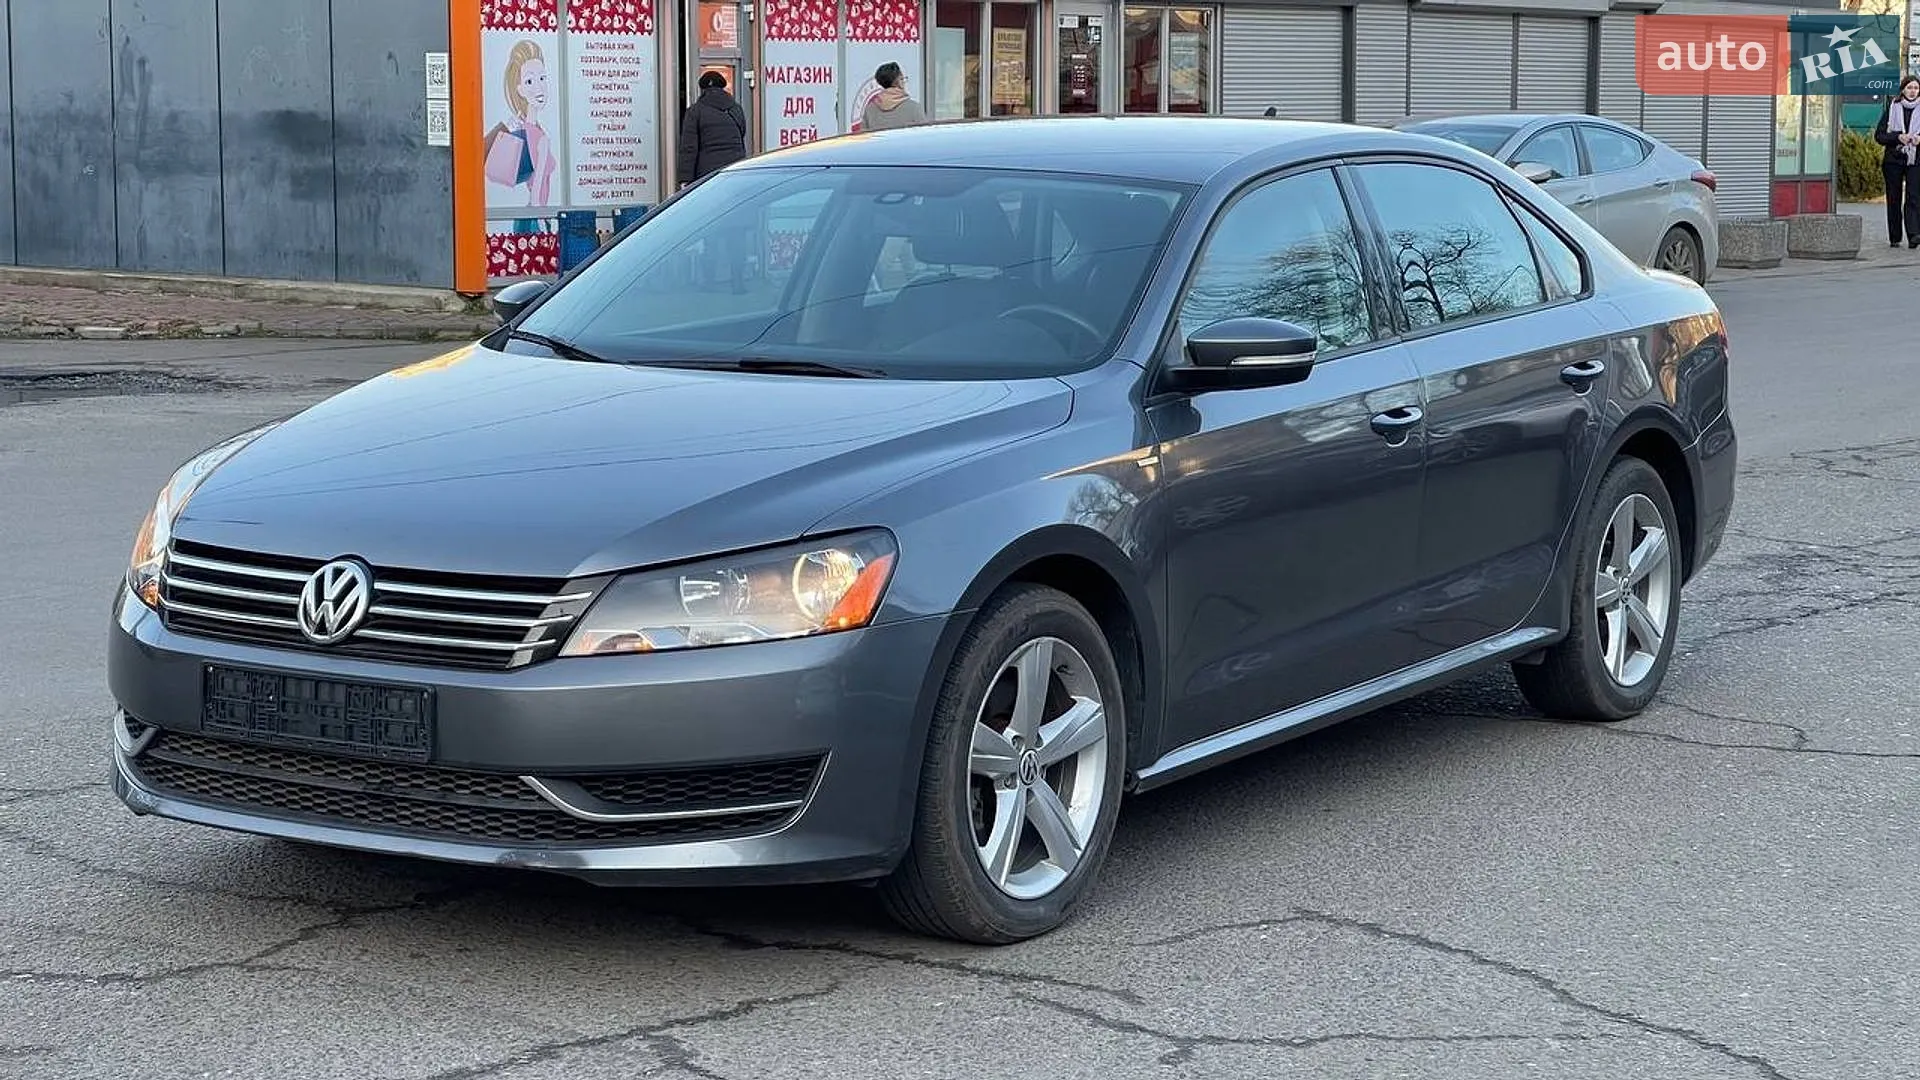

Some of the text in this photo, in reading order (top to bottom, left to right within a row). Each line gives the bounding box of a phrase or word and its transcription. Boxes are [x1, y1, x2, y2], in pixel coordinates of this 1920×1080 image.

[765, 66, 833, 84] МАГАЗИН
[592, 83, 630, 91] КОСМЕТИКА
[783, 97, 815, 118] ДЛЯ
[780, 124, 818, 146] ВСЕЙ
[300, 561, 367, 639] VW
